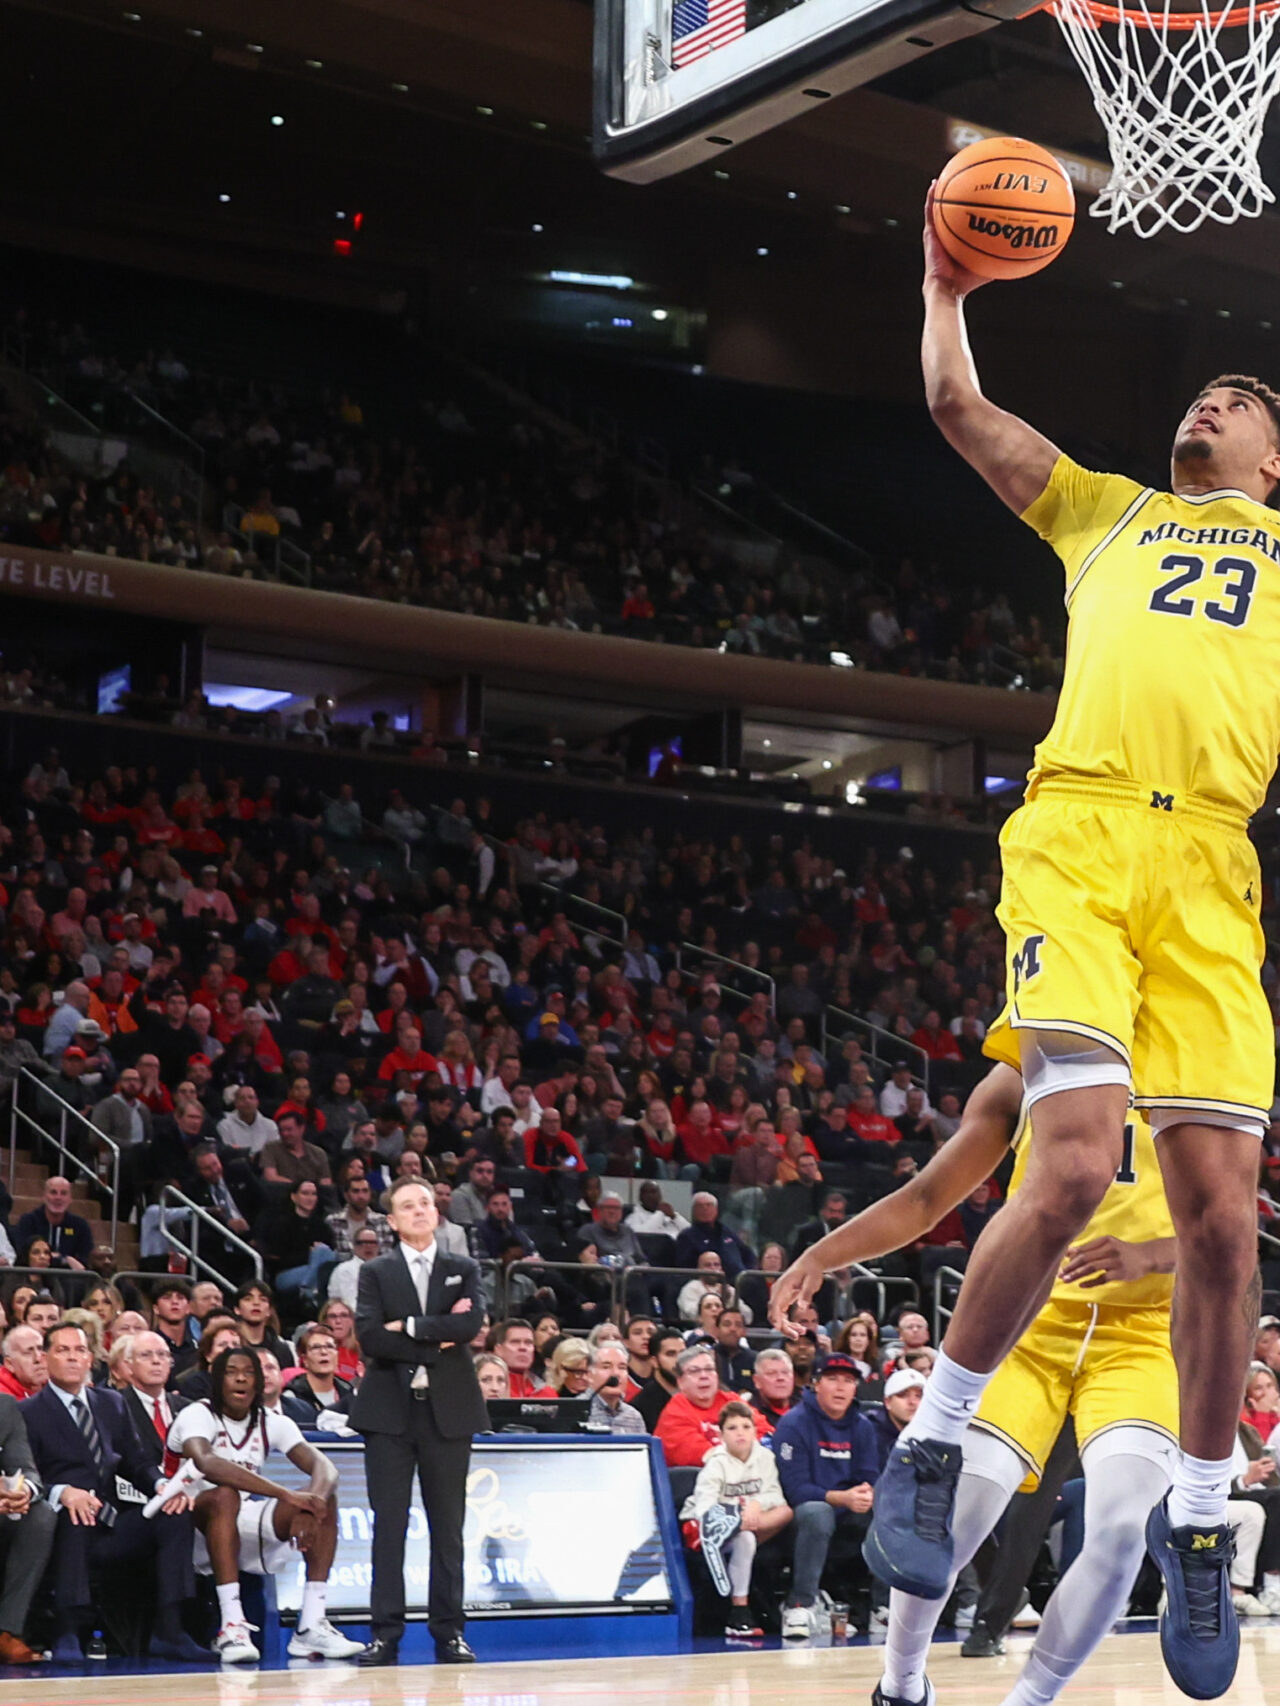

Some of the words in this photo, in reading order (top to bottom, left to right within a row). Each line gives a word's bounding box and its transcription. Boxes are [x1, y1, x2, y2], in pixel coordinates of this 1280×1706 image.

[966, 211, 1058, 249] Wilson
[33, 563, 115, 599] LEVEL
[1149, 554, 1257, 628] 23
[1150, 790, 1174, 812] M
[1012, 934, 1045, 988] M
[1191, 1533, 1219, 1551] M
